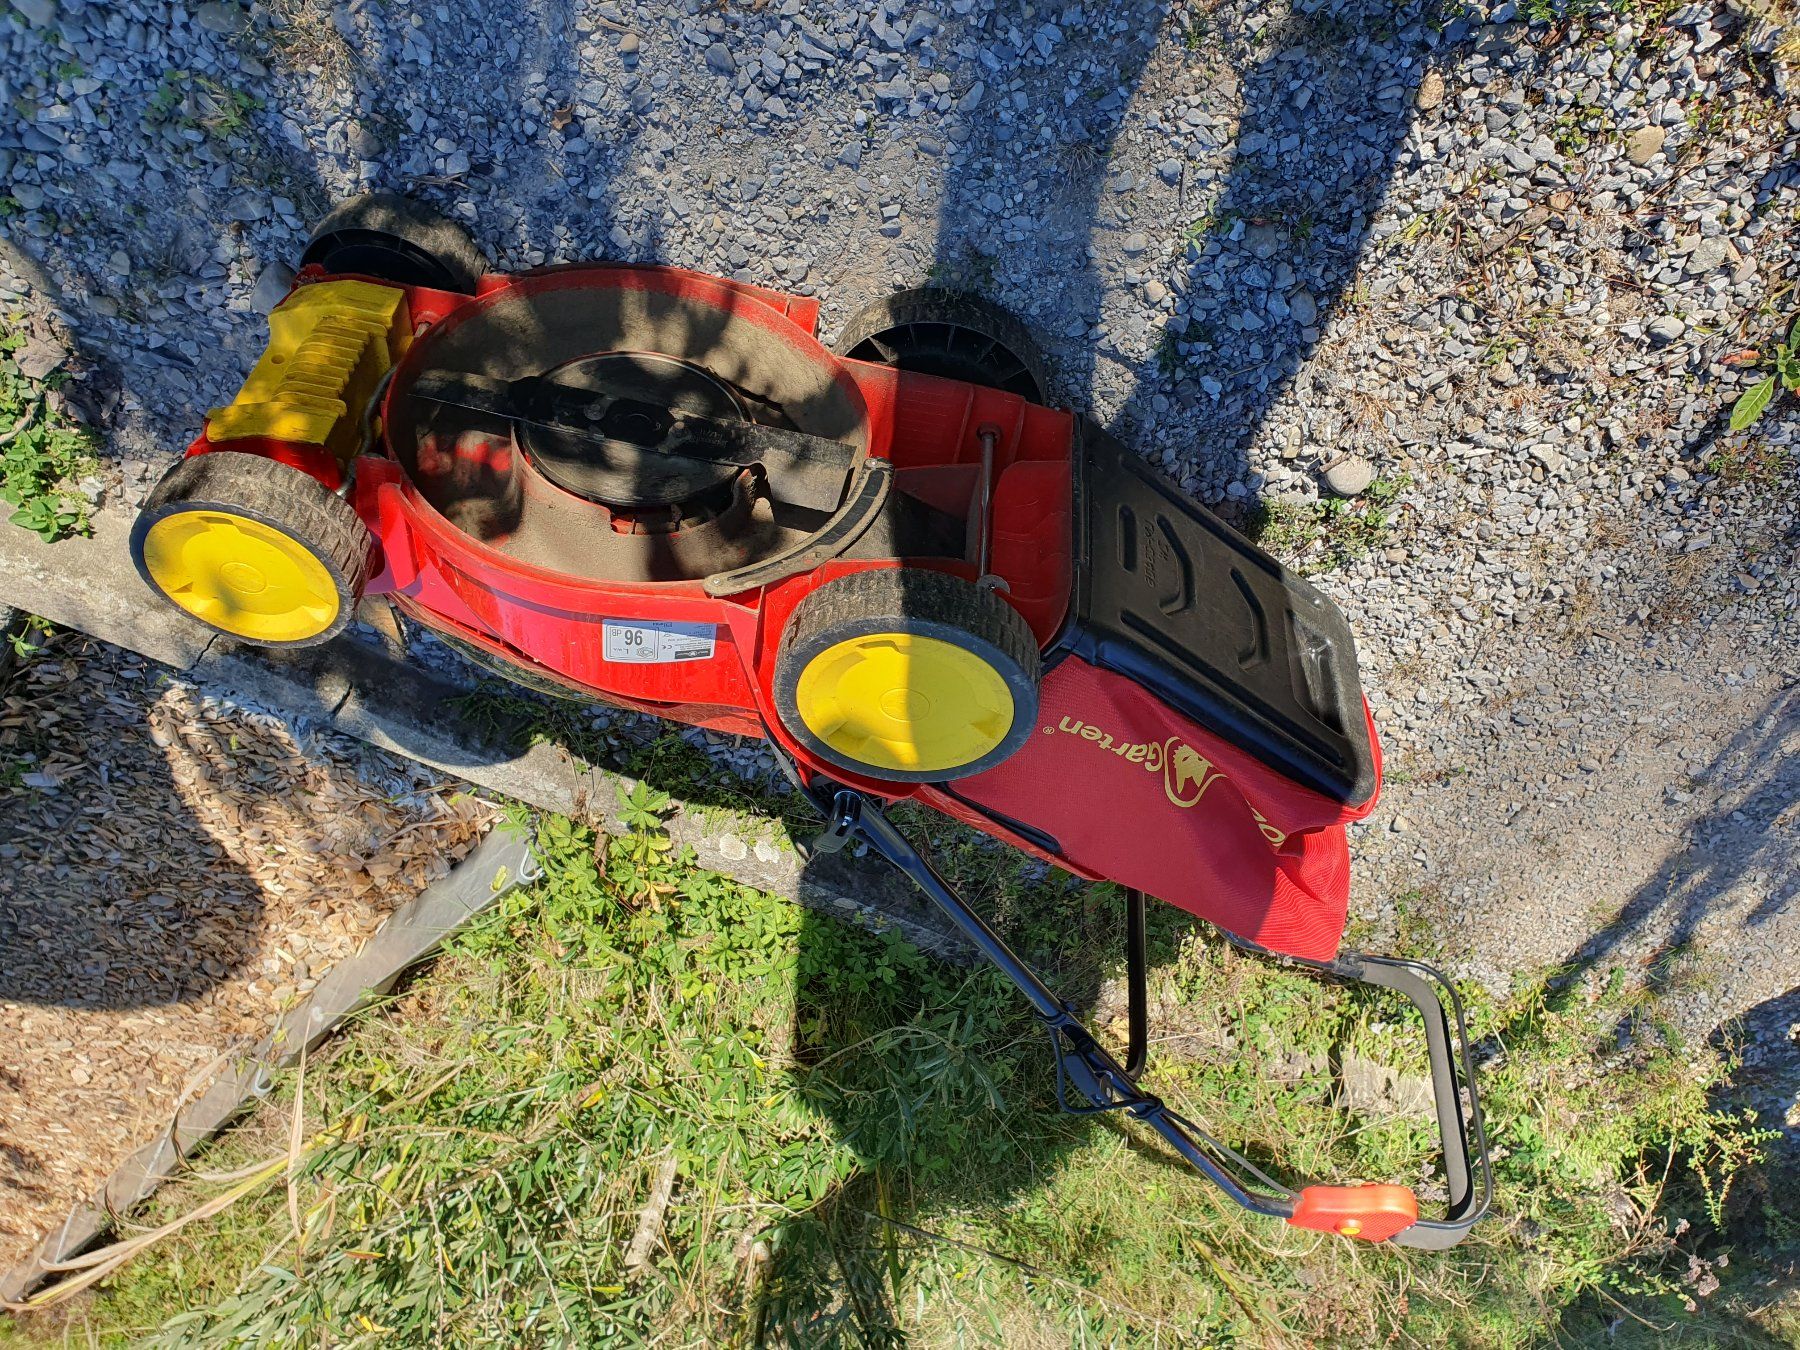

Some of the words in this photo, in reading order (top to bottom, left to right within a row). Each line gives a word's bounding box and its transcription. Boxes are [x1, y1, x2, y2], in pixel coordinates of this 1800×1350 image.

[611, 628, 622, 637] dB
[624, 629, 643, 646] 96
[1058, 715, 1164, 772] Garten
